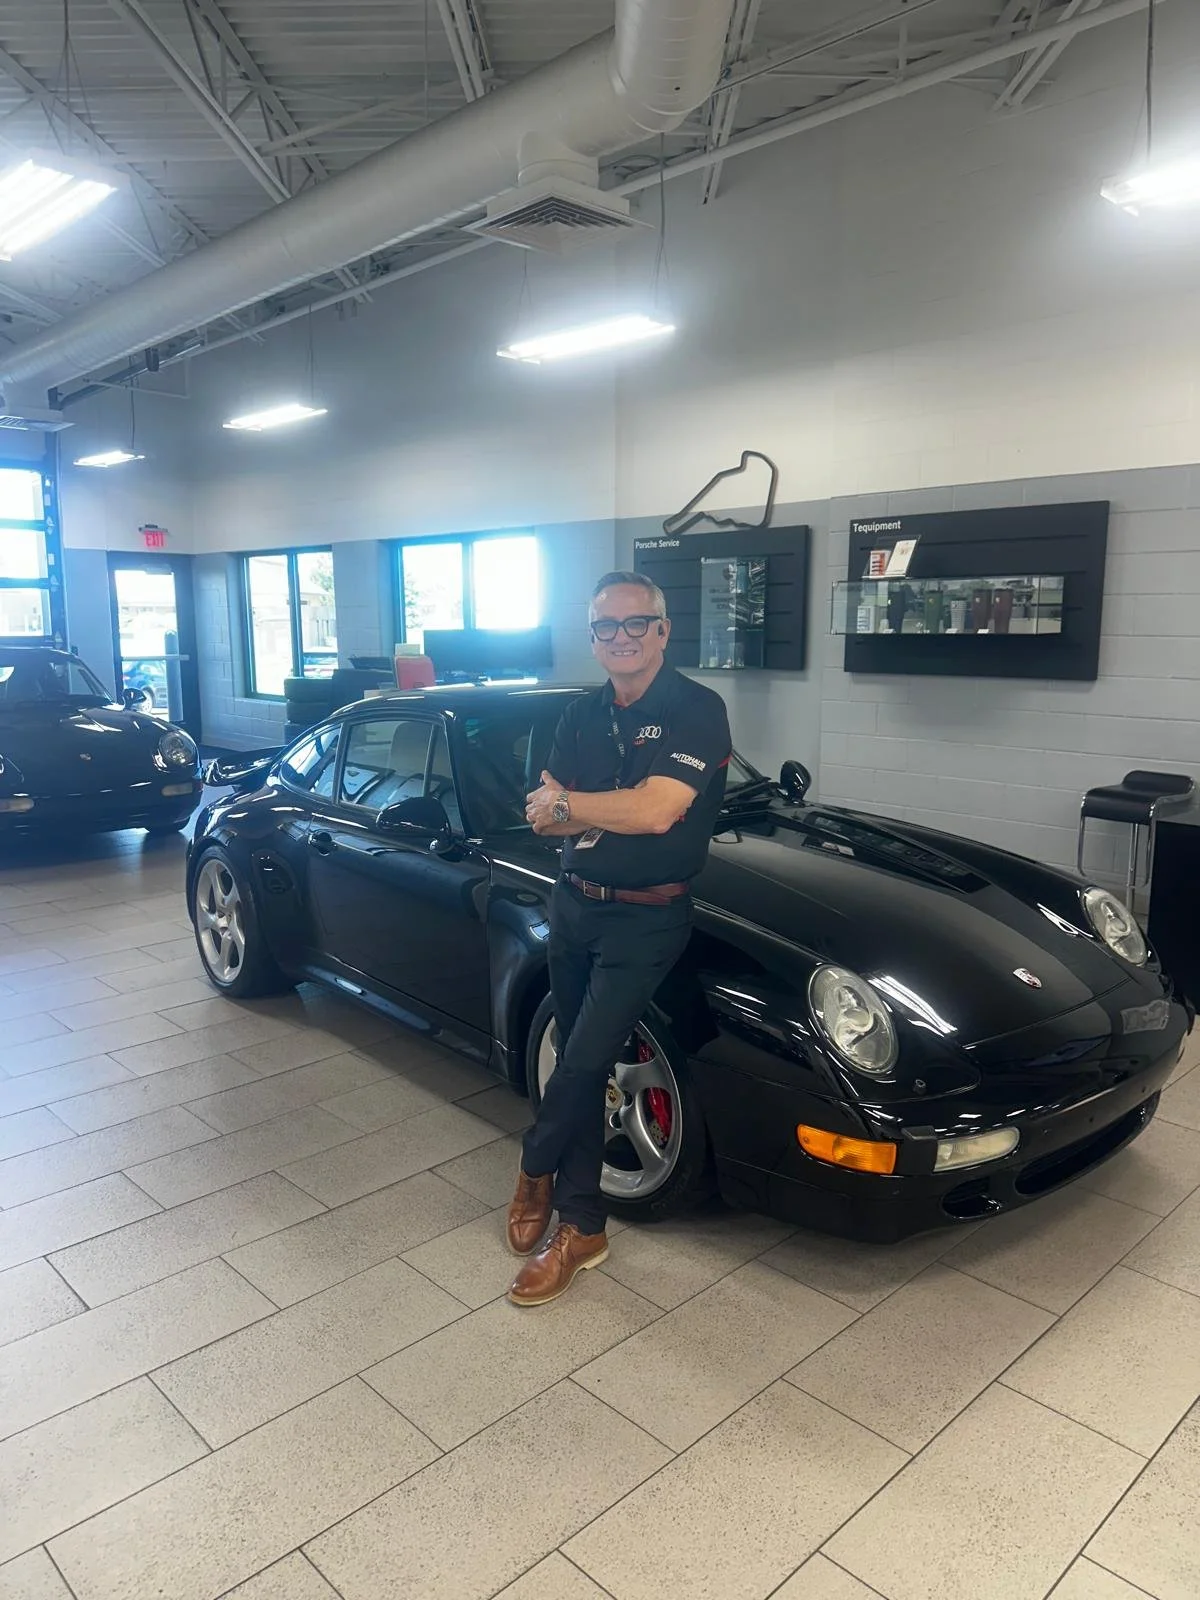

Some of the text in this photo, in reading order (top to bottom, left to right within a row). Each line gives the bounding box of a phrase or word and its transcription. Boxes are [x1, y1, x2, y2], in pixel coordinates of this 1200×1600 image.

[853, 520, 901, 534] Tequipment
[145, 531, 164, 547] EXIT
[635, 539, 680, 549] Porsche Service
[670, 752, 706, 769] AUTOHAUS
